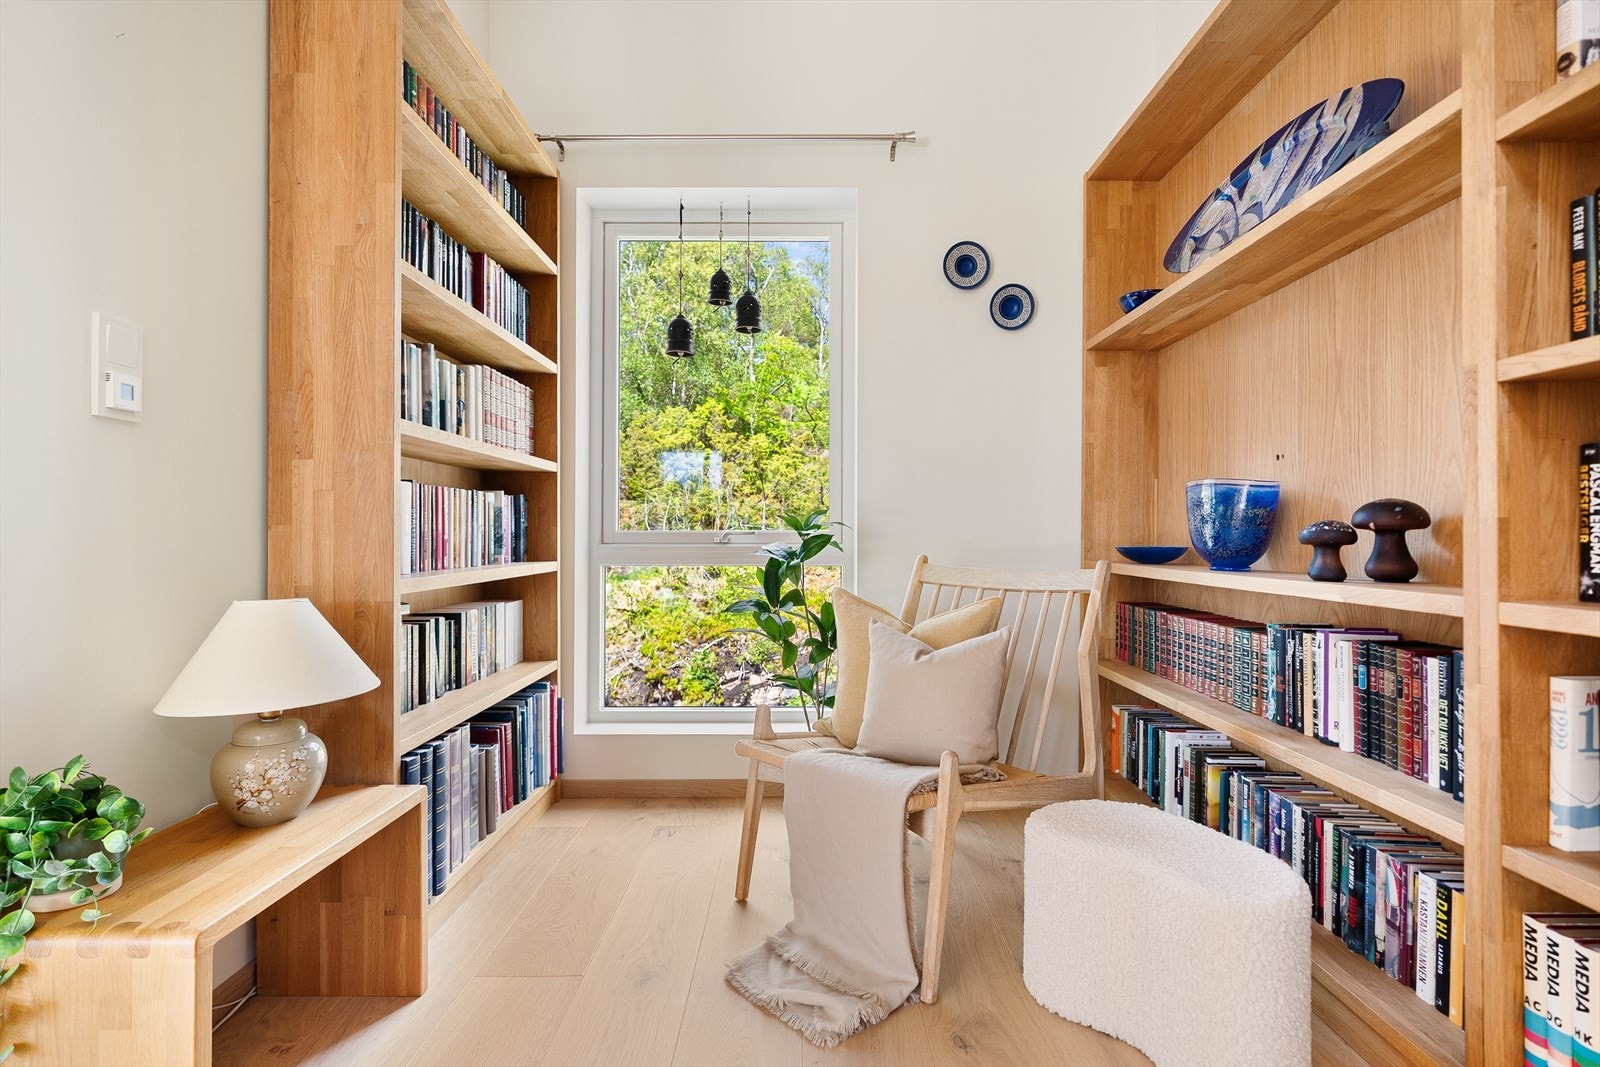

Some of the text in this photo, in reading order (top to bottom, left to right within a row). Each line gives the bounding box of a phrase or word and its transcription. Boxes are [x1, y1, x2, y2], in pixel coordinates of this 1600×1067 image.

[1572, 206, 1585, 251] PETER MAY
[1572, 260, 1590, 333] BLODETS BÅND
[1589, 463, 1600, 513] PASCAL
[1589, 515, 1600, 574] ENGMAN
[1439, 698, 1449, 717] DET
[1439, 717, 1449, 730] DU
[1551, 708, 1569, 750] 1222
[1439, 730, 1449, 752] IKKE
[1439, 752, 1449, 771] VET
[1417, 898, 1429, 985] KASTANJEMANNEN
[1436, 896, 1449, 942] DAHL
[1437, 944, 1445, 975] LAZARUS
[1524, 923, 1538, 982] MEDIA
[1546, 936, 1560, 997] MEDIA
[1575, 950, 1590, 1013] MEDIA
